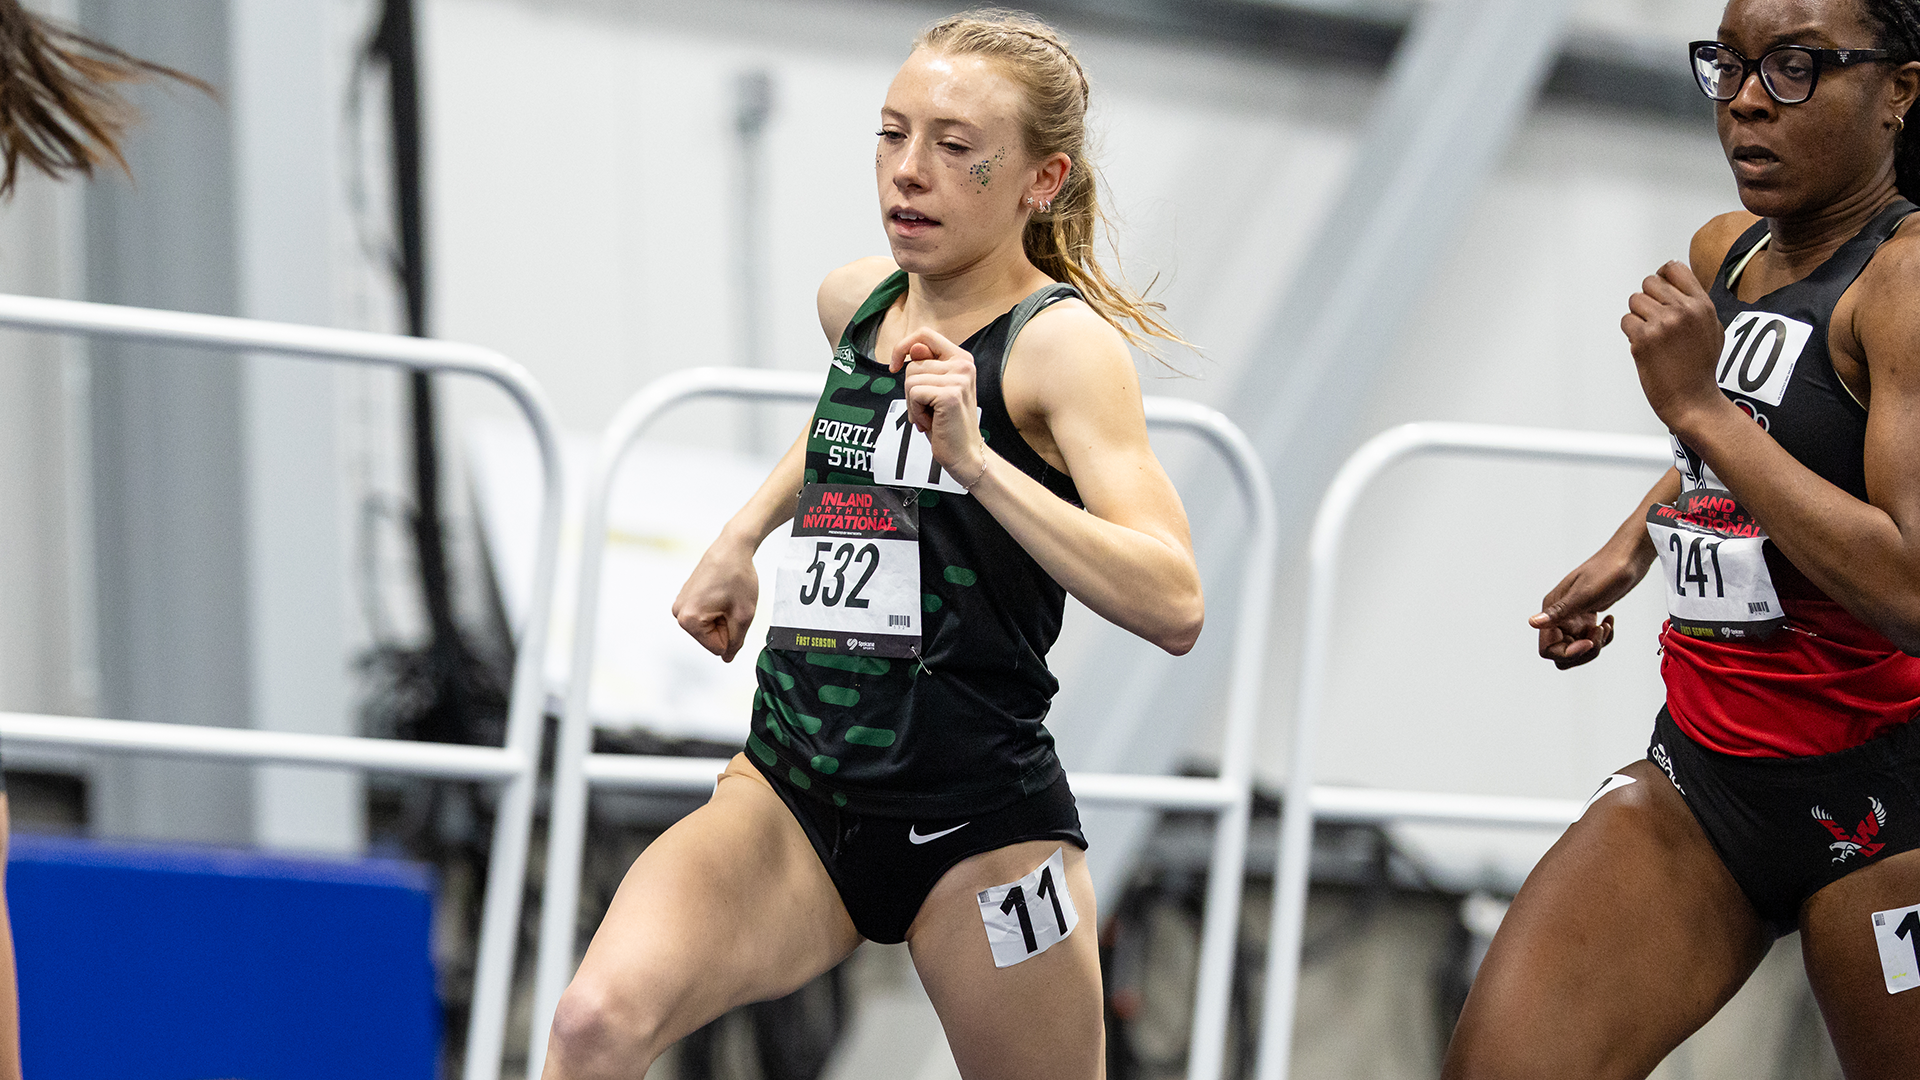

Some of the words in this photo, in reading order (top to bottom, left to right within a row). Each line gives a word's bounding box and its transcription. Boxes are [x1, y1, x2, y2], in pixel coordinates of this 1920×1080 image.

[1718, 317, 1787, 393] 10
[813, 419, 876, 448] PORTL
[808, 506, 891, 517] NORTHWEST
[821, 492, 873, 508] INLAND
[802, 514, 898, 532] INVITATIONAL
[799, 541, 880, 609] 532
[1669, 532, 1725, 598] 241
[811, 637, 837, 649] SEASON
[1000, 865, 1068, 954] 11
